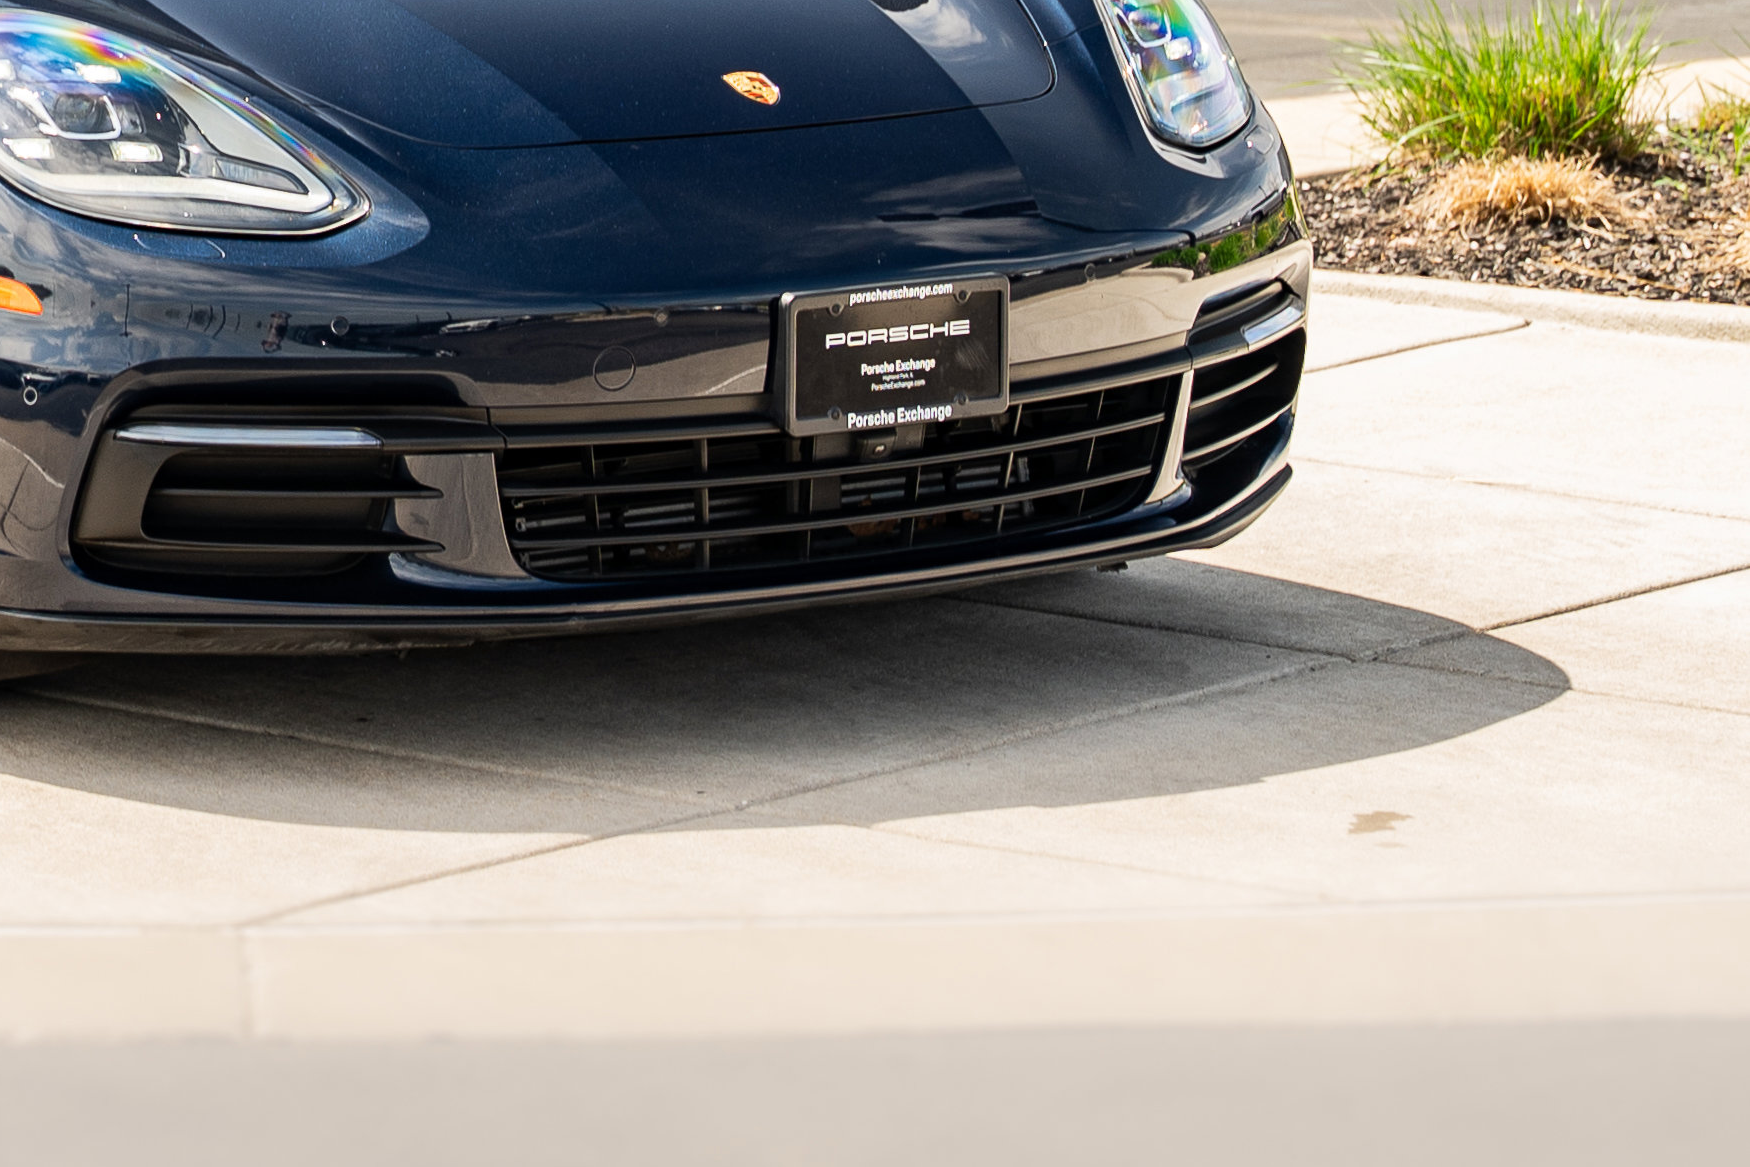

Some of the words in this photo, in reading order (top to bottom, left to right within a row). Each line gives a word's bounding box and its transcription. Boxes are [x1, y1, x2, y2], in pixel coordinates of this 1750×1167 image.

[849, 283, 953, 306] porscheexchange.com
[825, 319, 971, 349] PORSCHE
[861, 360, 895, 376] Porsche
[895, 358, 936, 372] Exchange
[847, 408, 895, 429] Porsche
[896, 404, 952, 423] Exchange
